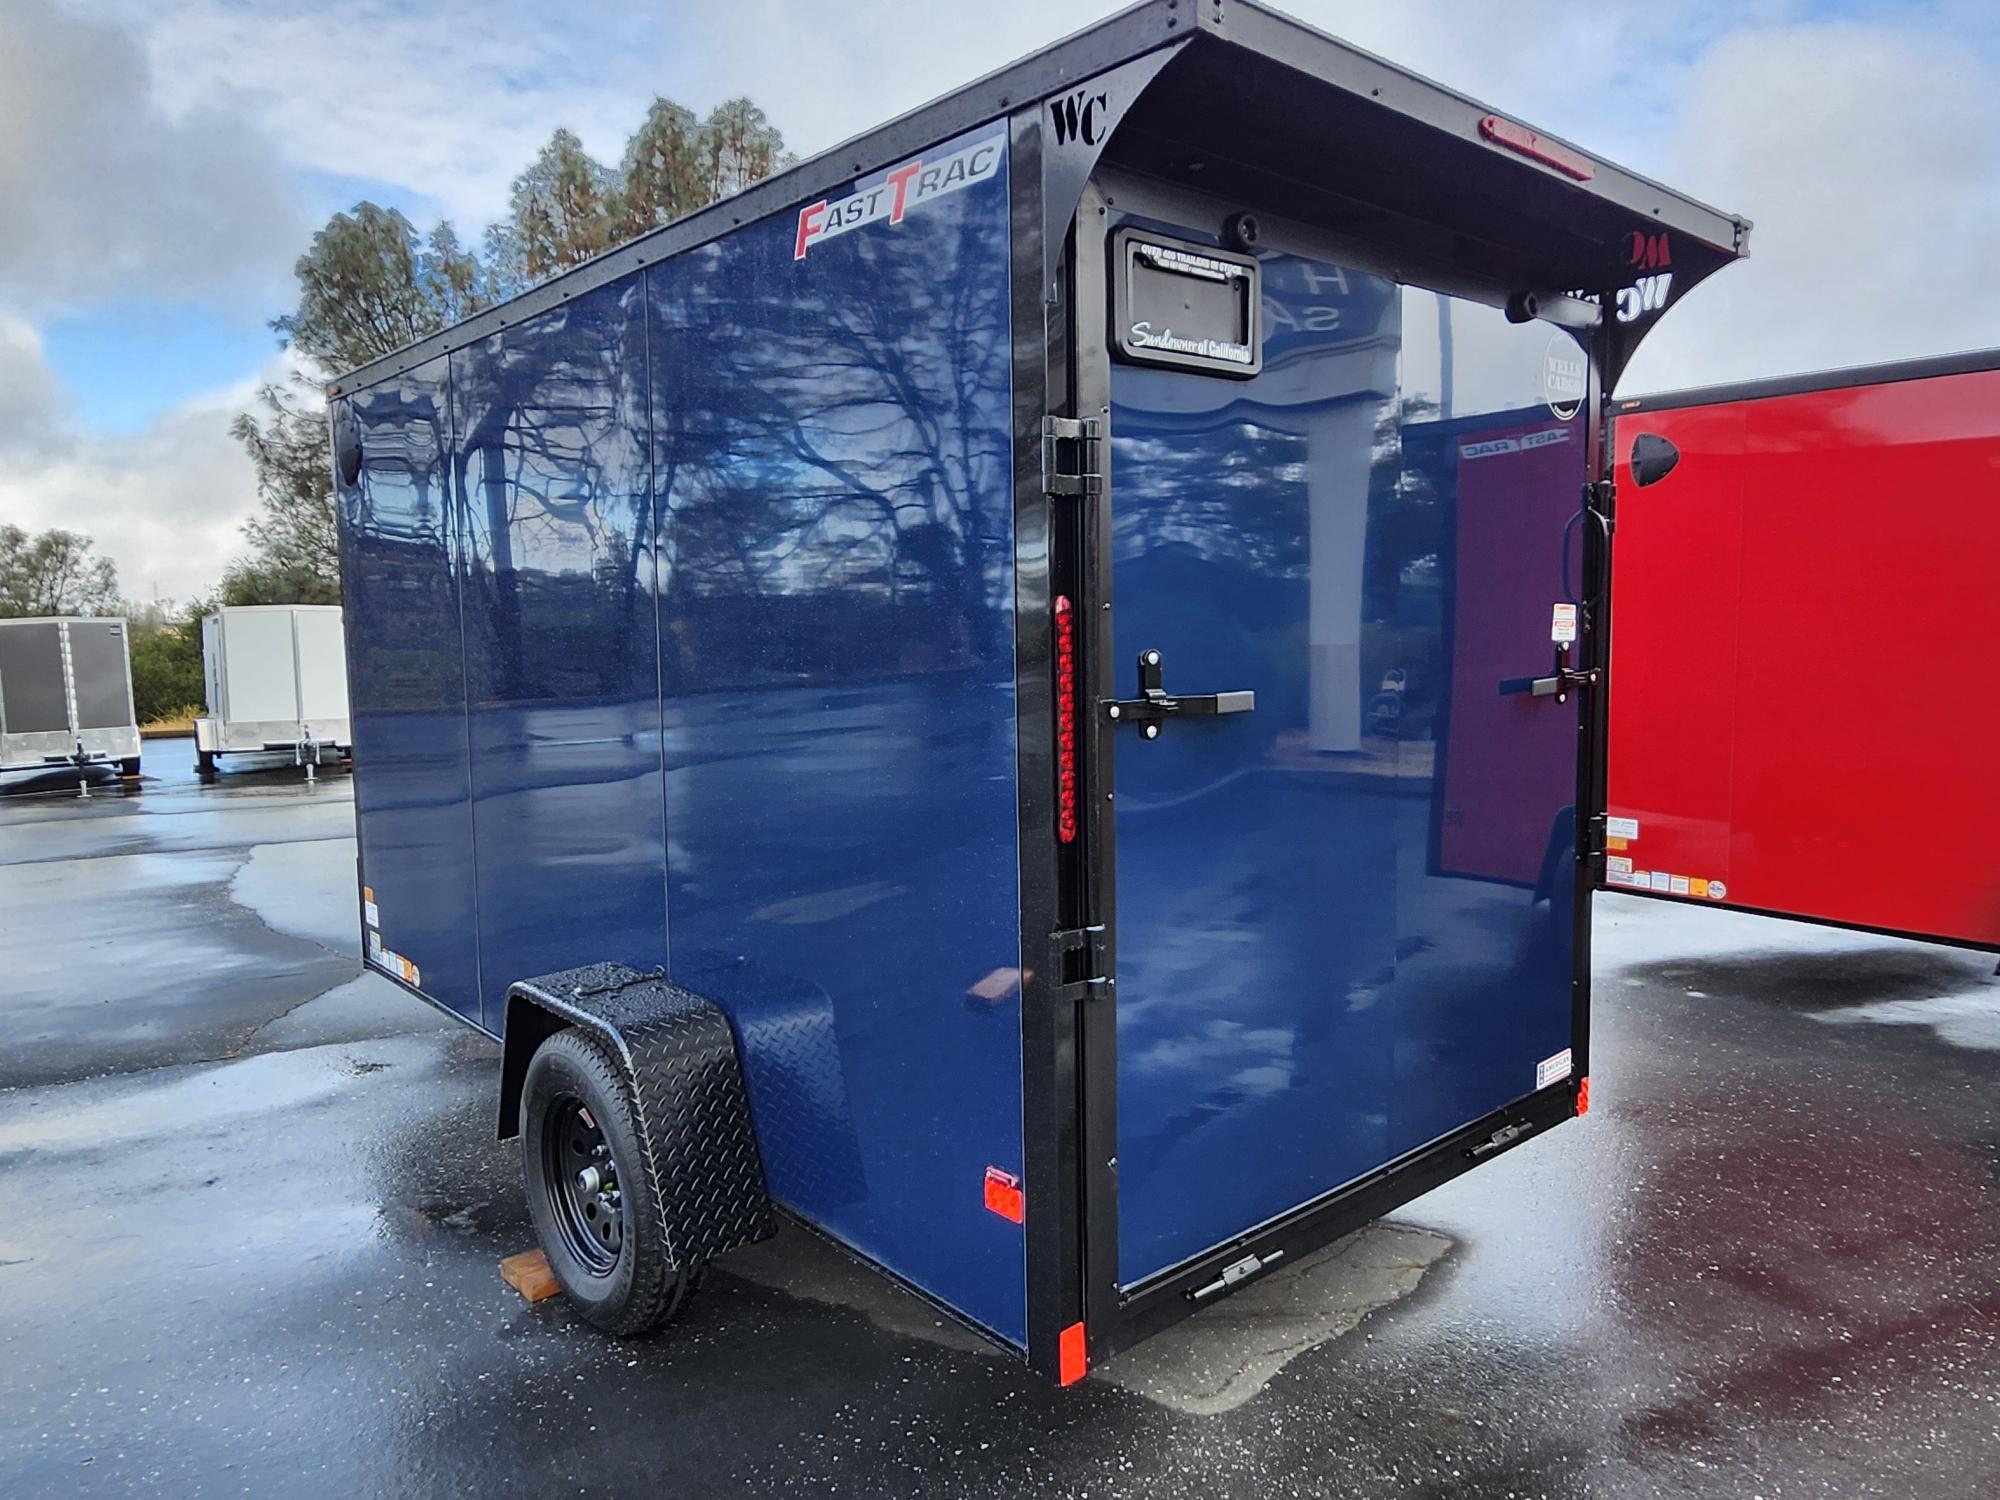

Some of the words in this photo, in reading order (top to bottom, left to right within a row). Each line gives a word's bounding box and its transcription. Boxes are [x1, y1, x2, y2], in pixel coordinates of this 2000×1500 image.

[1050, 90, 1107, 146] WC
[795, 189, 884, 260] FAST
[887, 146, 995, 225] TRAC
[1141, 244, 1162, 258] OVER
[1177, 252, 1210, 269] TRAILERS
[1131, 321, 1197, 351] Sundowner
[1198, 339, 1208, 355] of
[1209, 340, 1250, 363] California
[1548, 356, 1581, 378] WELLS
[1547, 374, 1583, 394] CARGO
